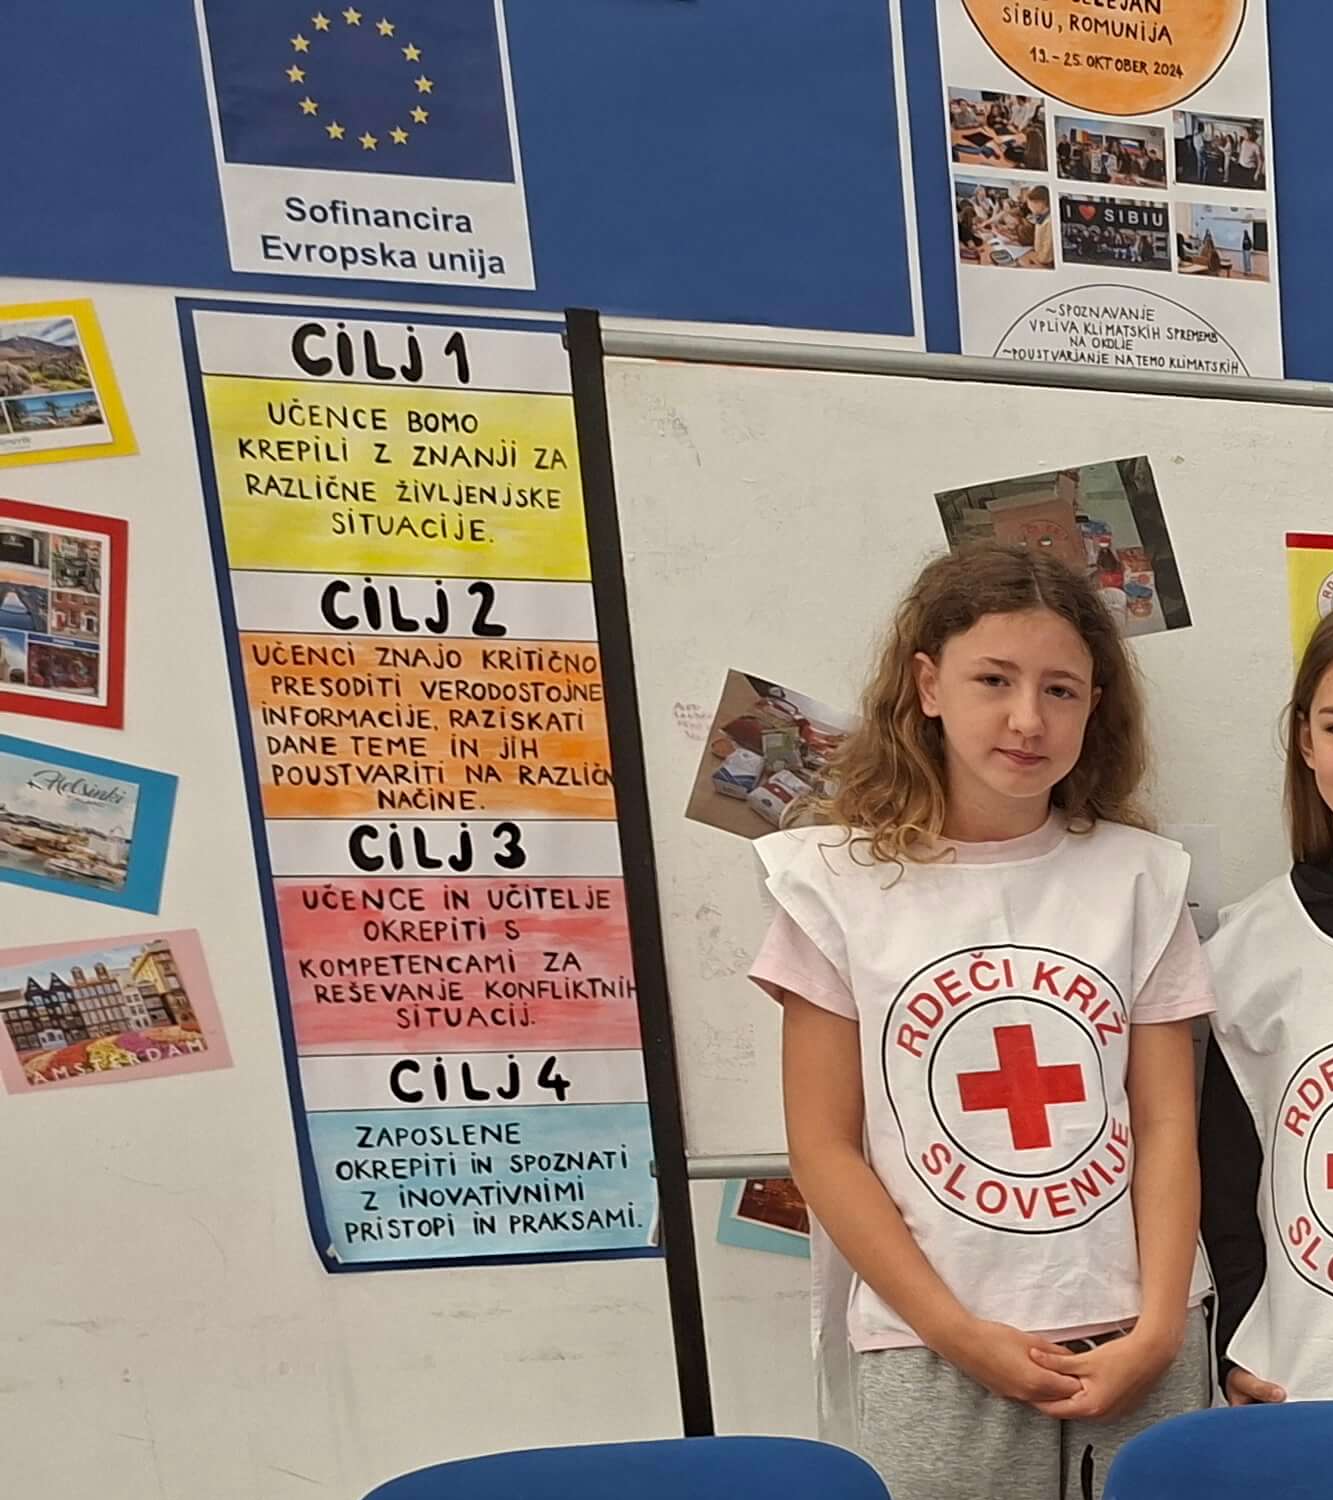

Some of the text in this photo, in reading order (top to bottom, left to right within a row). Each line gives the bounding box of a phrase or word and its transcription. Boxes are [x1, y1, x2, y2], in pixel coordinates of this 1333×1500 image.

[1002, 6, 1173, 46] SIBIU, ROMUNIJA
[1086, 56, 1184, 79] OKTOBER 2024
[285, 197, 472, 234] Sofinancira
[1104, 209, 1165, 227] SIBIU
[261, 235, 505, 277] Evropska unija
[1029, 319, 1079, 335] VPLIVA
[1069, 337, 1086, 348] NA
[291, 322, 471, 385] CILJ 1
[1115, 355, 1136, 367] NA
[267, 399, 479, 434] UČENCE BOMO
[239, 437, 568, 471] KREPILI Z ZNANJI ZA
[246, 474, 561, 510] RAZLIČNE ŽIVLJENJSKE
[331, 510, 494, 544] SITUACIJE.
[320, 577, 508, 637] CILJ 2
[253, 642, 597, 674] UČENCI ZNAJO KRITIČNO
[271, 673, 603, 703] PRESODITI VERODOSTOJNE
[450, 706, 583, 731] RAZISKATI
[268, 735, 539, 759] DANE TEME IN JIH
[272, 760, 614, 787] POUSTVARITI NA RAZLIČN
[379, 787, 485, 812] NAČINE.
[349, 822, 527, 872] CILJ 3
[301, 884, 611, 911] UČENCE IN UČITELJE
[364, 917, 520, 943] OKREPITI S
[300, 949, 582, 978] KOMPETENCAMI ZA
[315, 977, 464, 1004] REŠEVANJE
[895, 951, 1128, 1059] RDEČI KRIŽ
[34, 1040, 206, 1084] AMSTERDAM
[389, 1054, 572, 1102] CILJ 4
[356, 1123, 521, 1150] ZAPOSLENE
[335, 1144, 628, 1182] OKREPITI IN SPOZNATI
[920, 1117, 1129, 1221] SLOVENIJE
[362, 1175, 585, 1211] Z INOVATIVNIMI
[345, 1215, 456, 1244] PRISTOPI
[473, 1212, 496, 1236] IN
